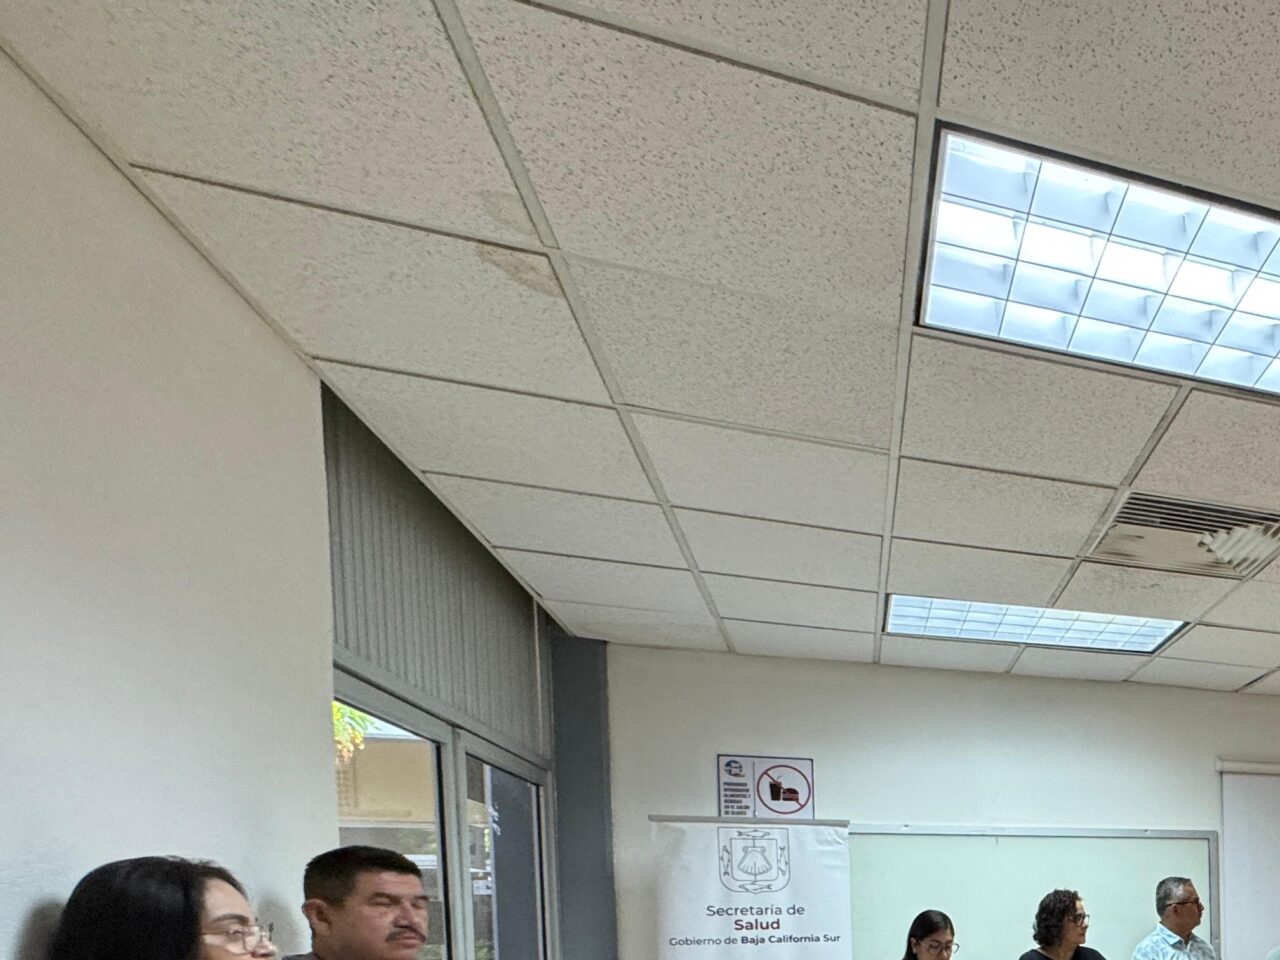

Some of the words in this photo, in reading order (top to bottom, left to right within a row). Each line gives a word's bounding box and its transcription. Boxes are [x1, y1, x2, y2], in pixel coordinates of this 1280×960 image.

[706, 904, 783, 917] Secretaría
[786, 904, 805, 916] de
[734, 918, 781, 931] Salud
[669, 936, 722, 947] Gobierno
[724, 936, 738, 945] de
[741, 935, 765, 946] Baja
[768, 933, 820, 944] California
[823, 934, 840, 943] Sur
